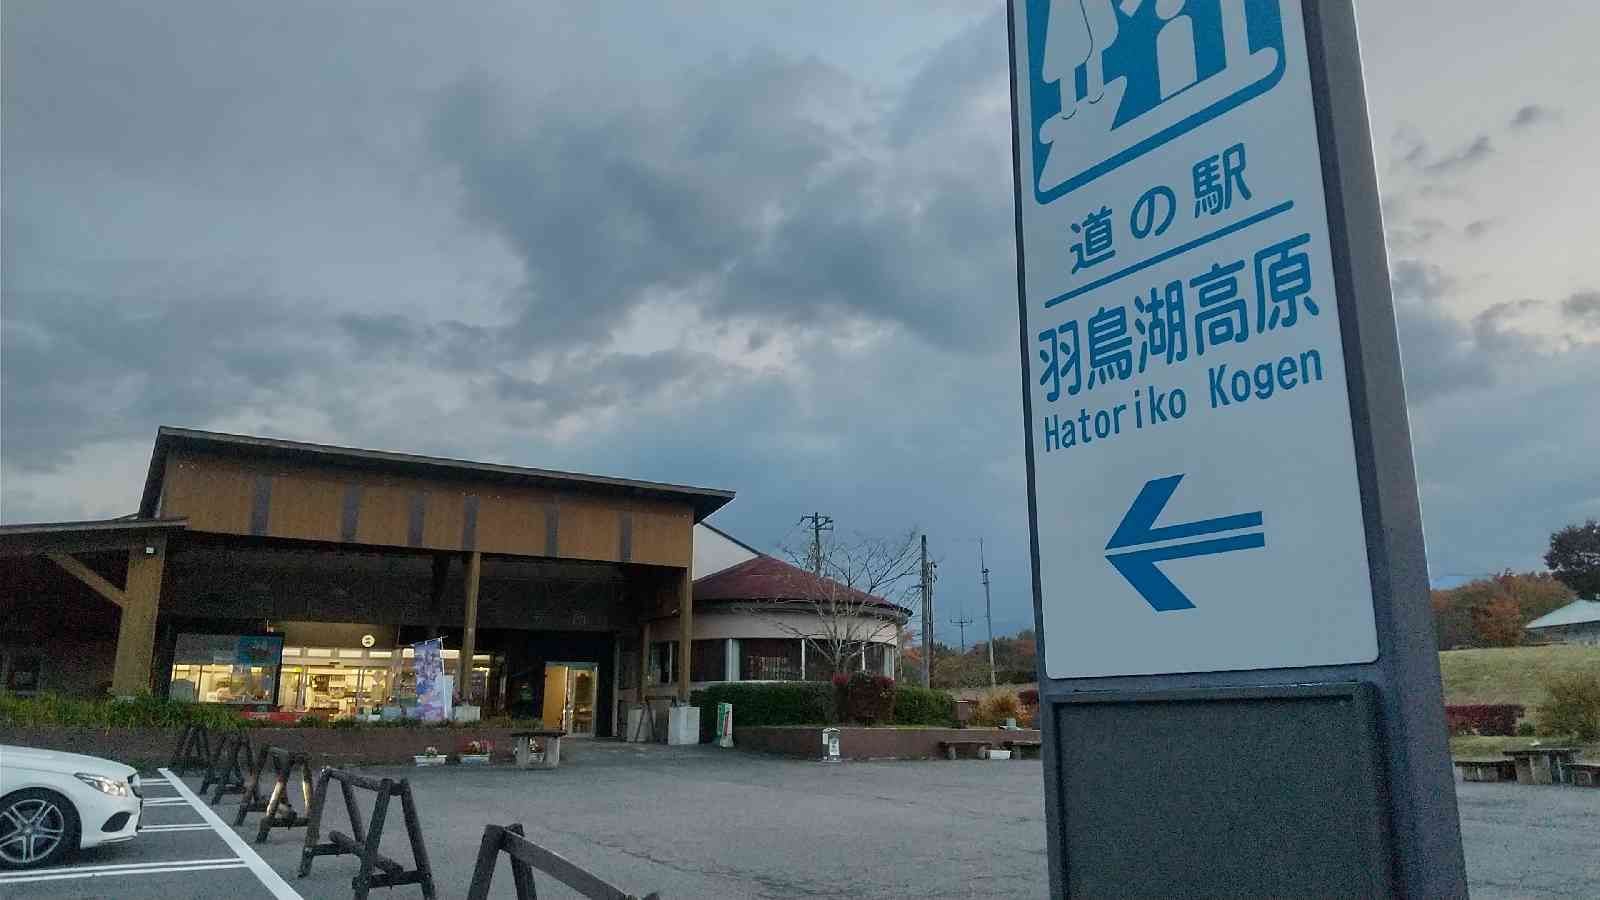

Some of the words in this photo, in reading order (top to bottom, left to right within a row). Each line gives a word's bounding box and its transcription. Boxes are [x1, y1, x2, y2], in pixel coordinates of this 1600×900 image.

[1069, 142, 1253, 275] 道の駅
[1038, 232, 1320, 403] 羽鳥湖高原
[1043, 385, 1188, 453] Hatoriko
[1207, 348, 1323, 409] Kogen
